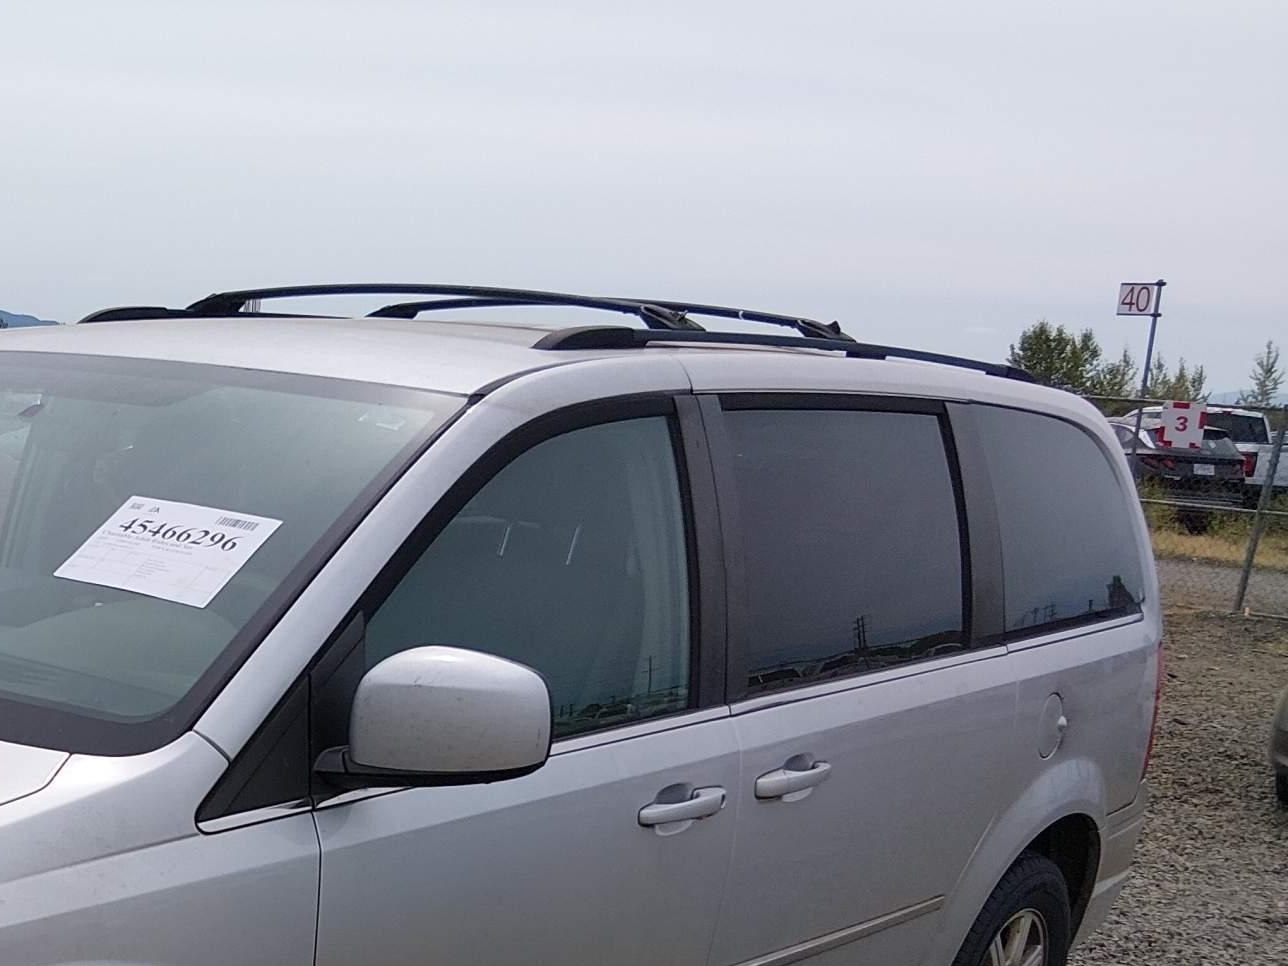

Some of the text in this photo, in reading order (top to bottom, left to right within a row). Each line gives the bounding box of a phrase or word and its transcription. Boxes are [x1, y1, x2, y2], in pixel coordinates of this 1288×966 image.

[1121, 286, 1151, 312] 40
[1174, 416, 1188, 432] 3
[119, 517, 243, 551] 45466296
